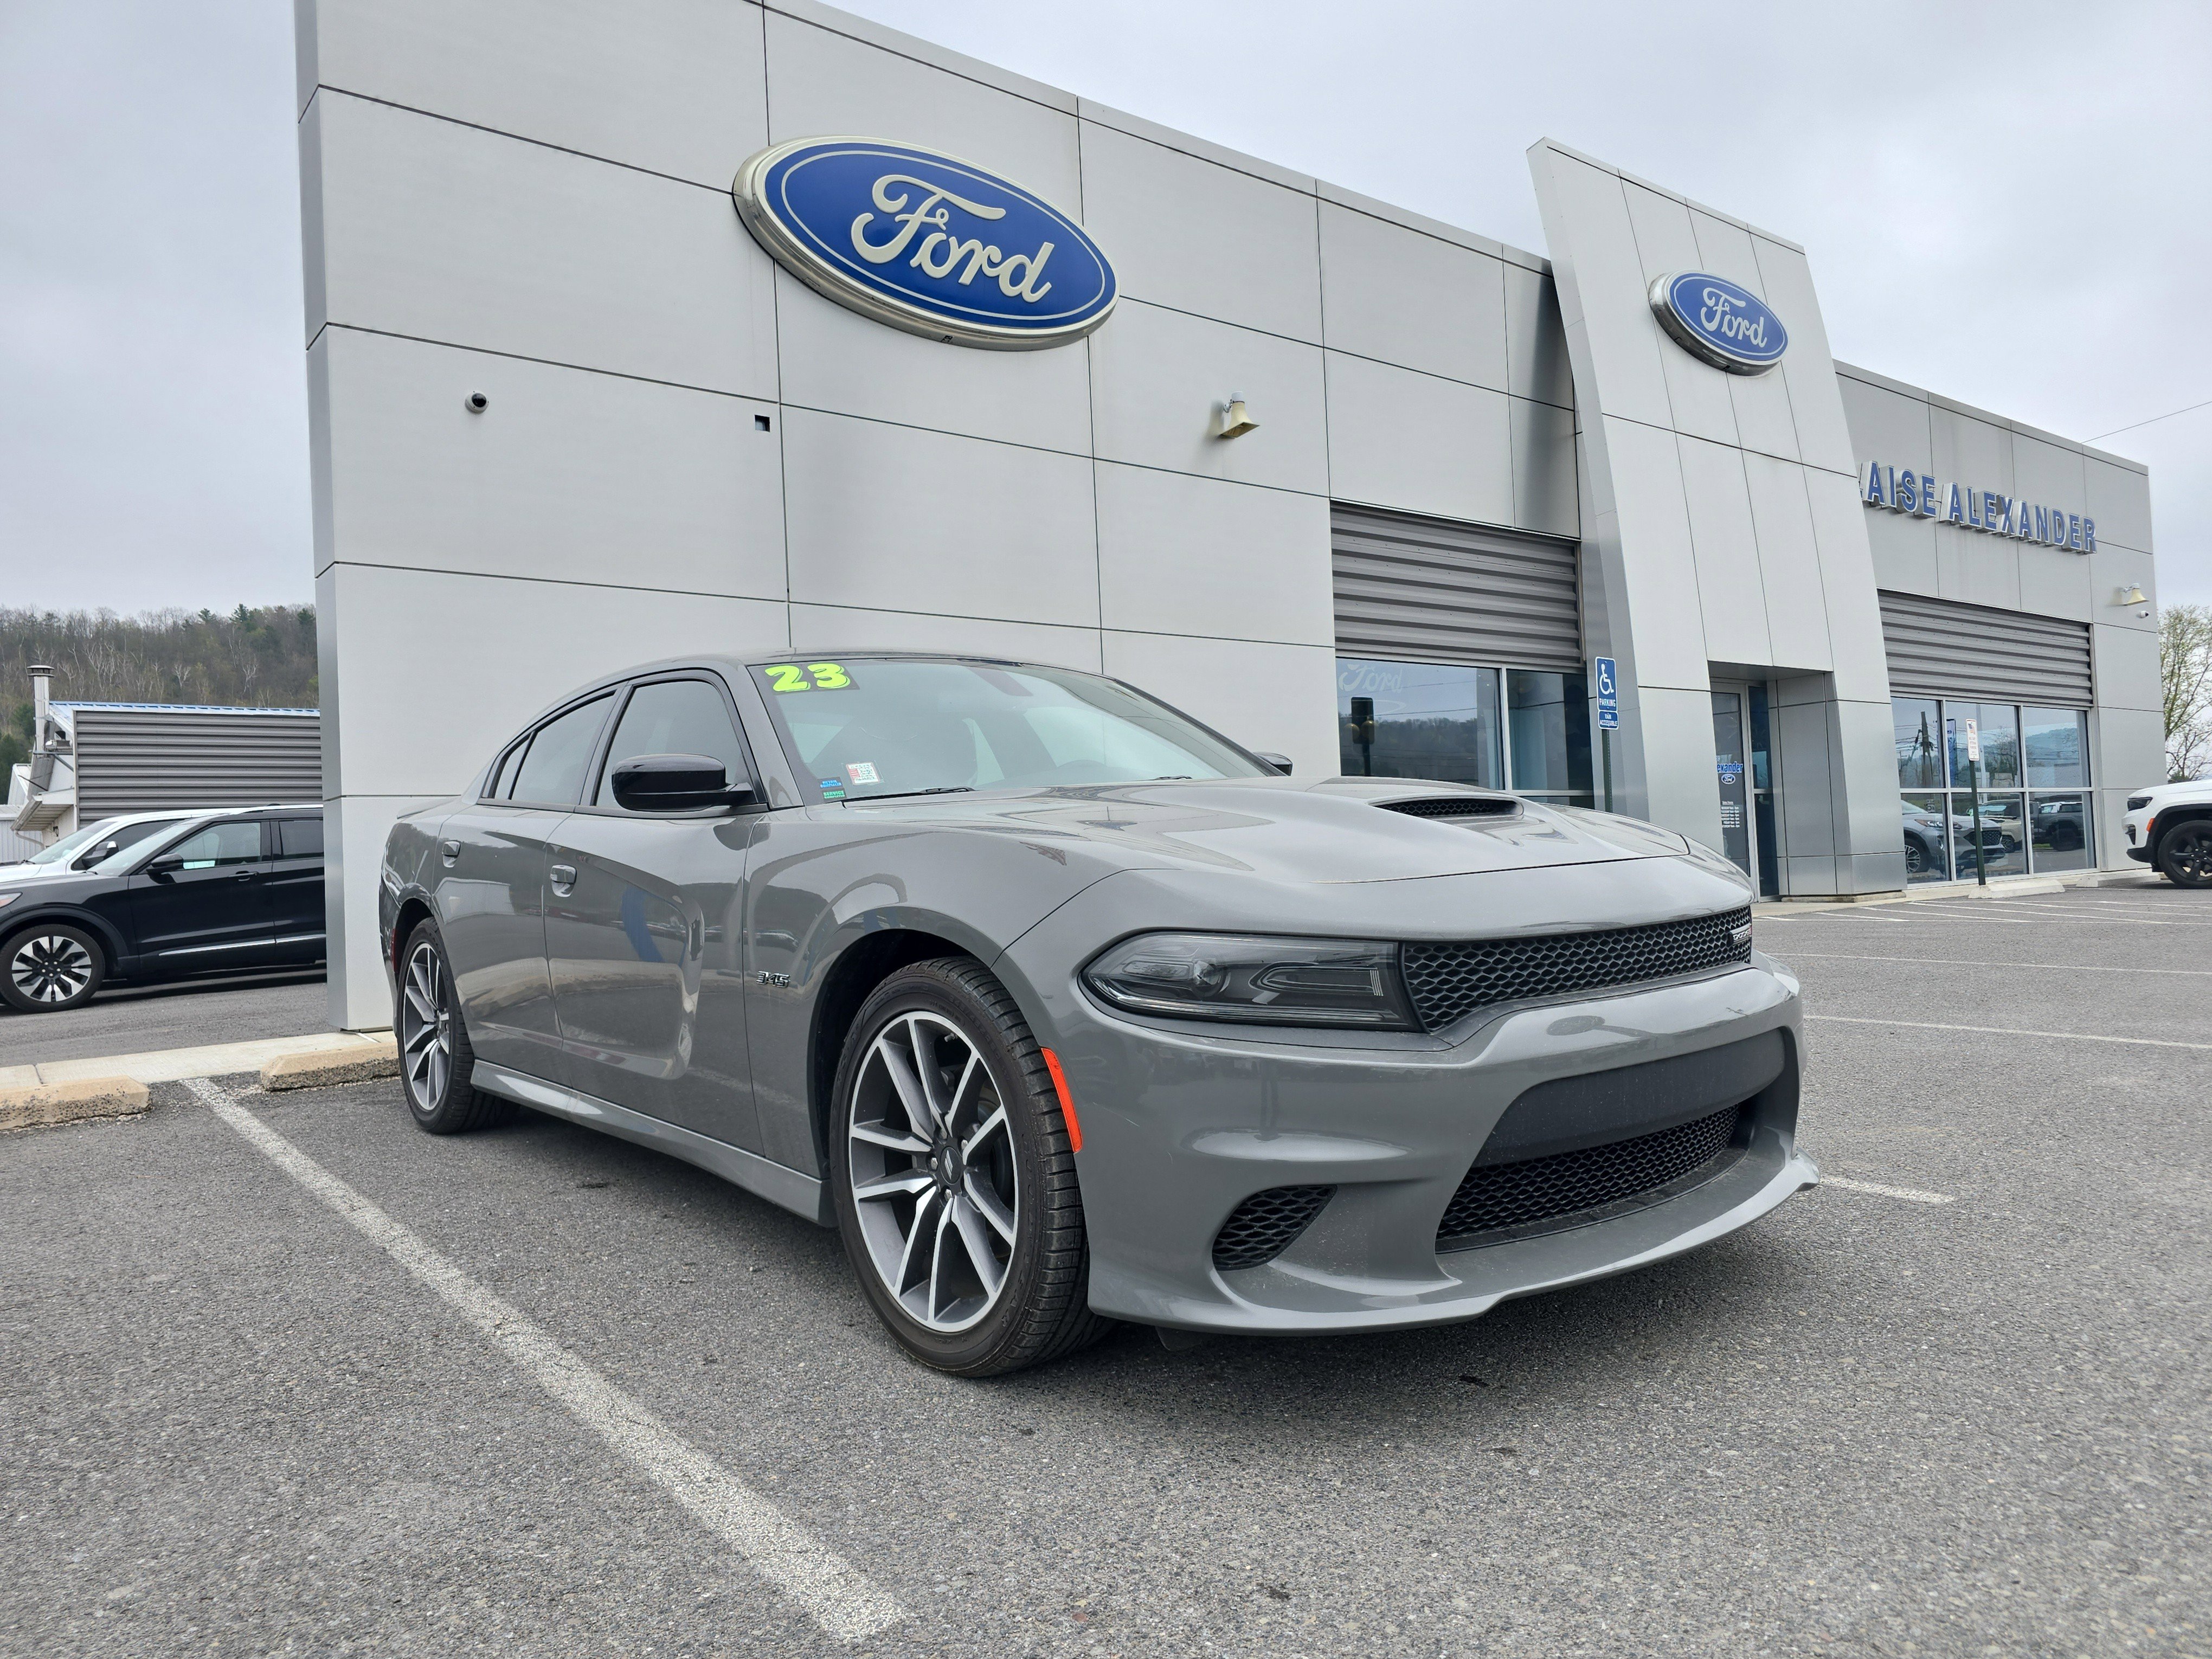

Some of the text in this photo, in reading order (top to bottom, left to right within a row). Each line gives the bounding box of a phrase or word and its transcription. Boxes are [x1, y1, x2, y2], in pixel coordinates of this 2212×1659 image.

[851, 173, 1054, 303] Ford
[1700, 287, 1767, 348] Ford
[1859, 460, 2097, 554] AISE ALEXANDER
[764, 663, 851, 692] 23
[1599, 698, 1616, 707] PARKING
[756, 970, 790, 988] 345
